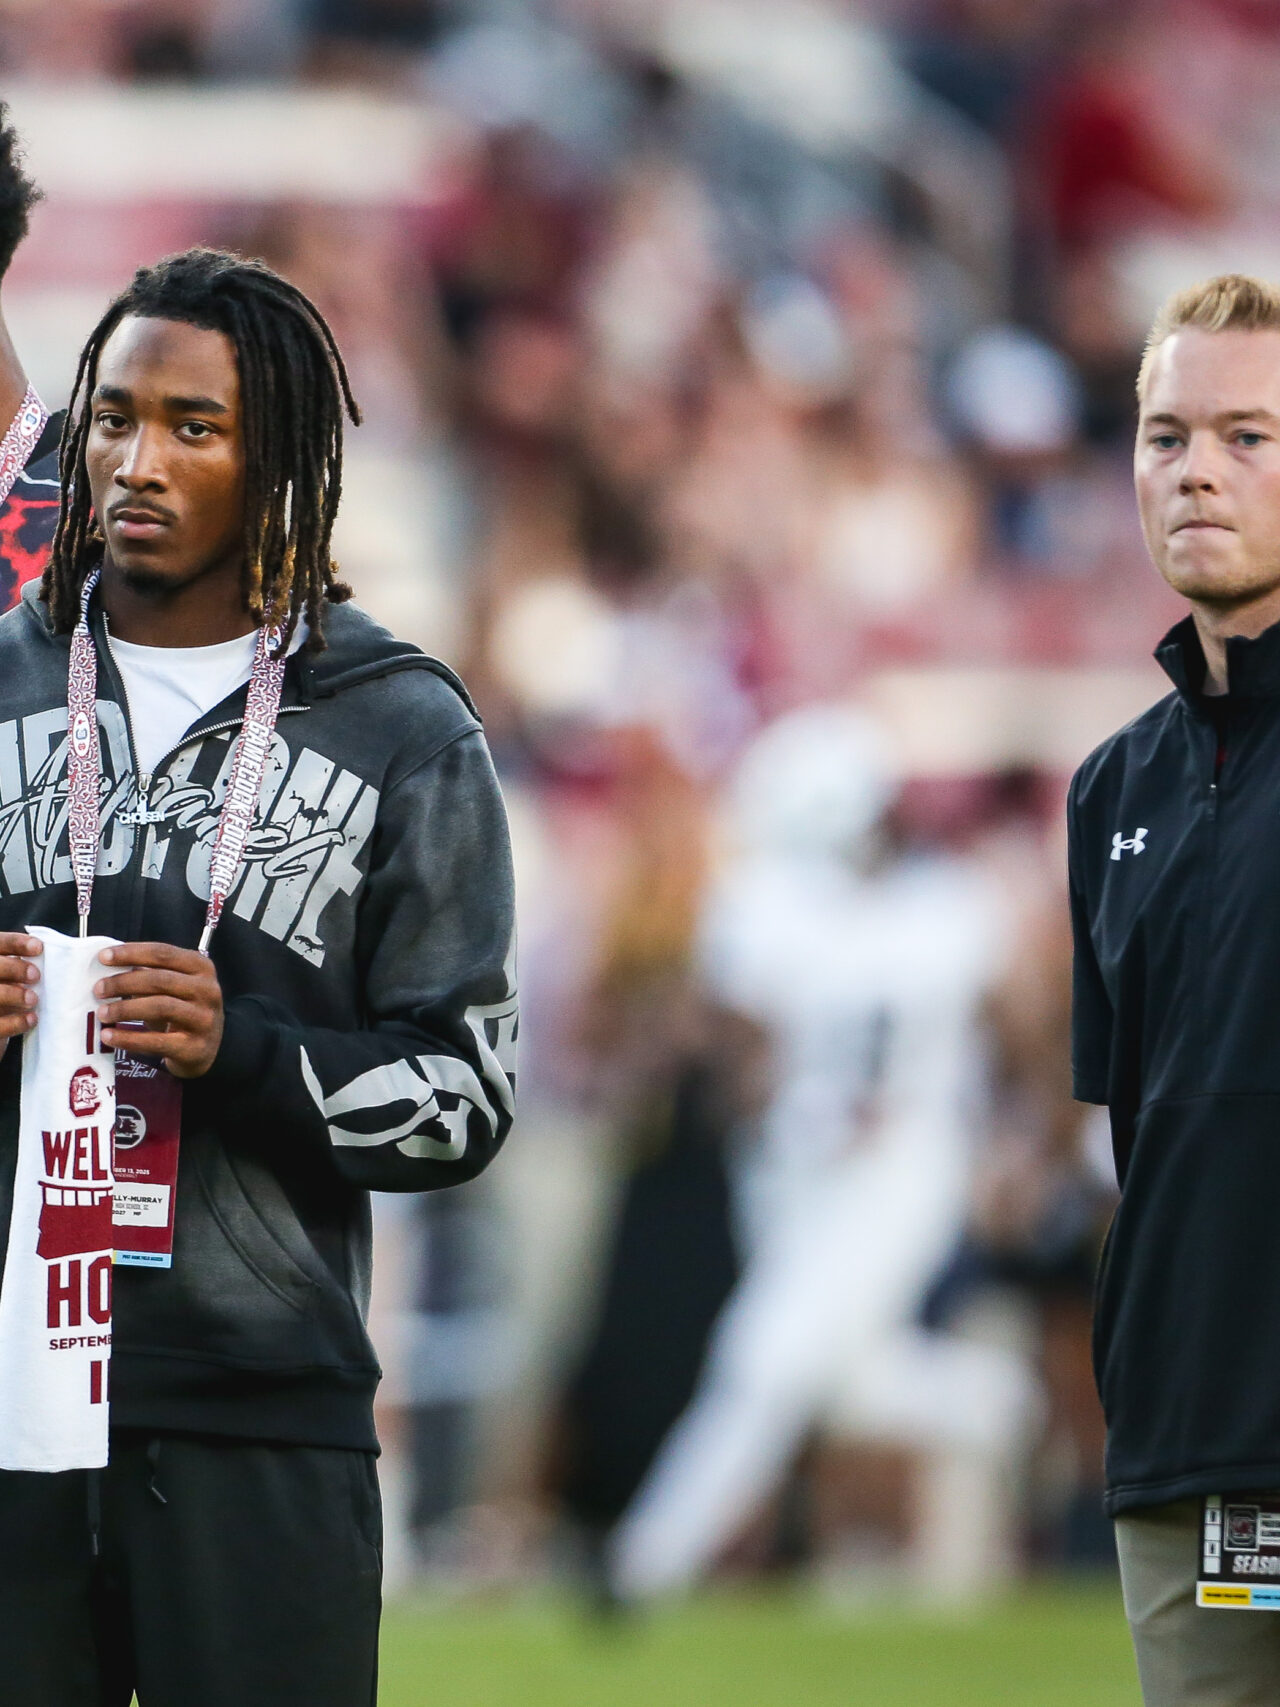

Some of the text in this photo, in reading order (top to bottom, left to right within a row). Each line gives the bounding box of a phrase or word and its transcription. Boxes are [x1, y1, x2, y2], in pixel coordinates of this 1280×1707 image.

[211, 720, 270, 896] GAMECOCK FOOTBALL
[115, 1066, 157, 1078] ootball
[41, 1126, 115, 1180] WEL
[113, 1194, 162, 1204] LLY-MURRAY
